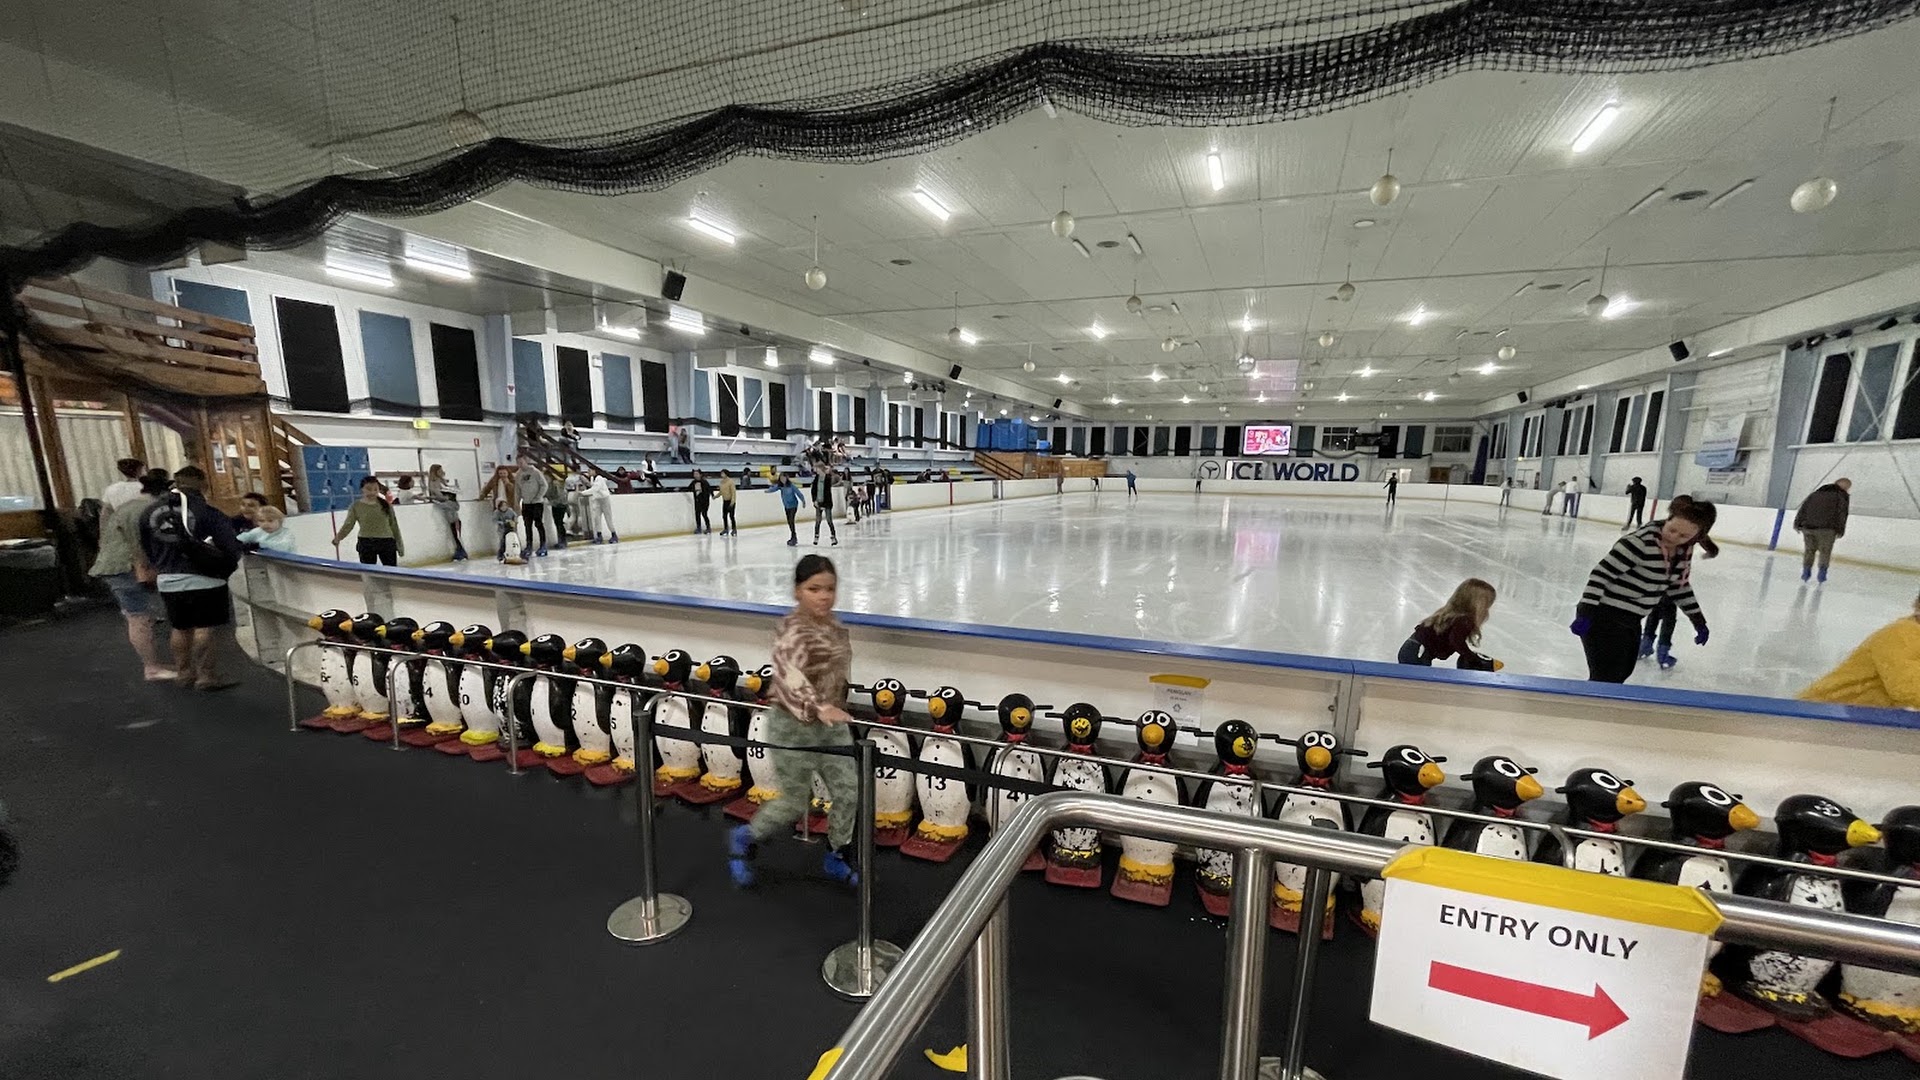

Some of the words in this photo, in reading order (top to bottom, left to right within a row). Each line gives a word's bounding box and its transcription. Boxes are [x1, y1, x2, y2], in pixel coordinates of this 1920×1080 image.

[1273, 463, 1359, 481] WORLD
[926, 776, 947, 790] 13
[1440, 904, 1539, 941] ENTRY
[1548, 926, 1638, 960] ONLY
